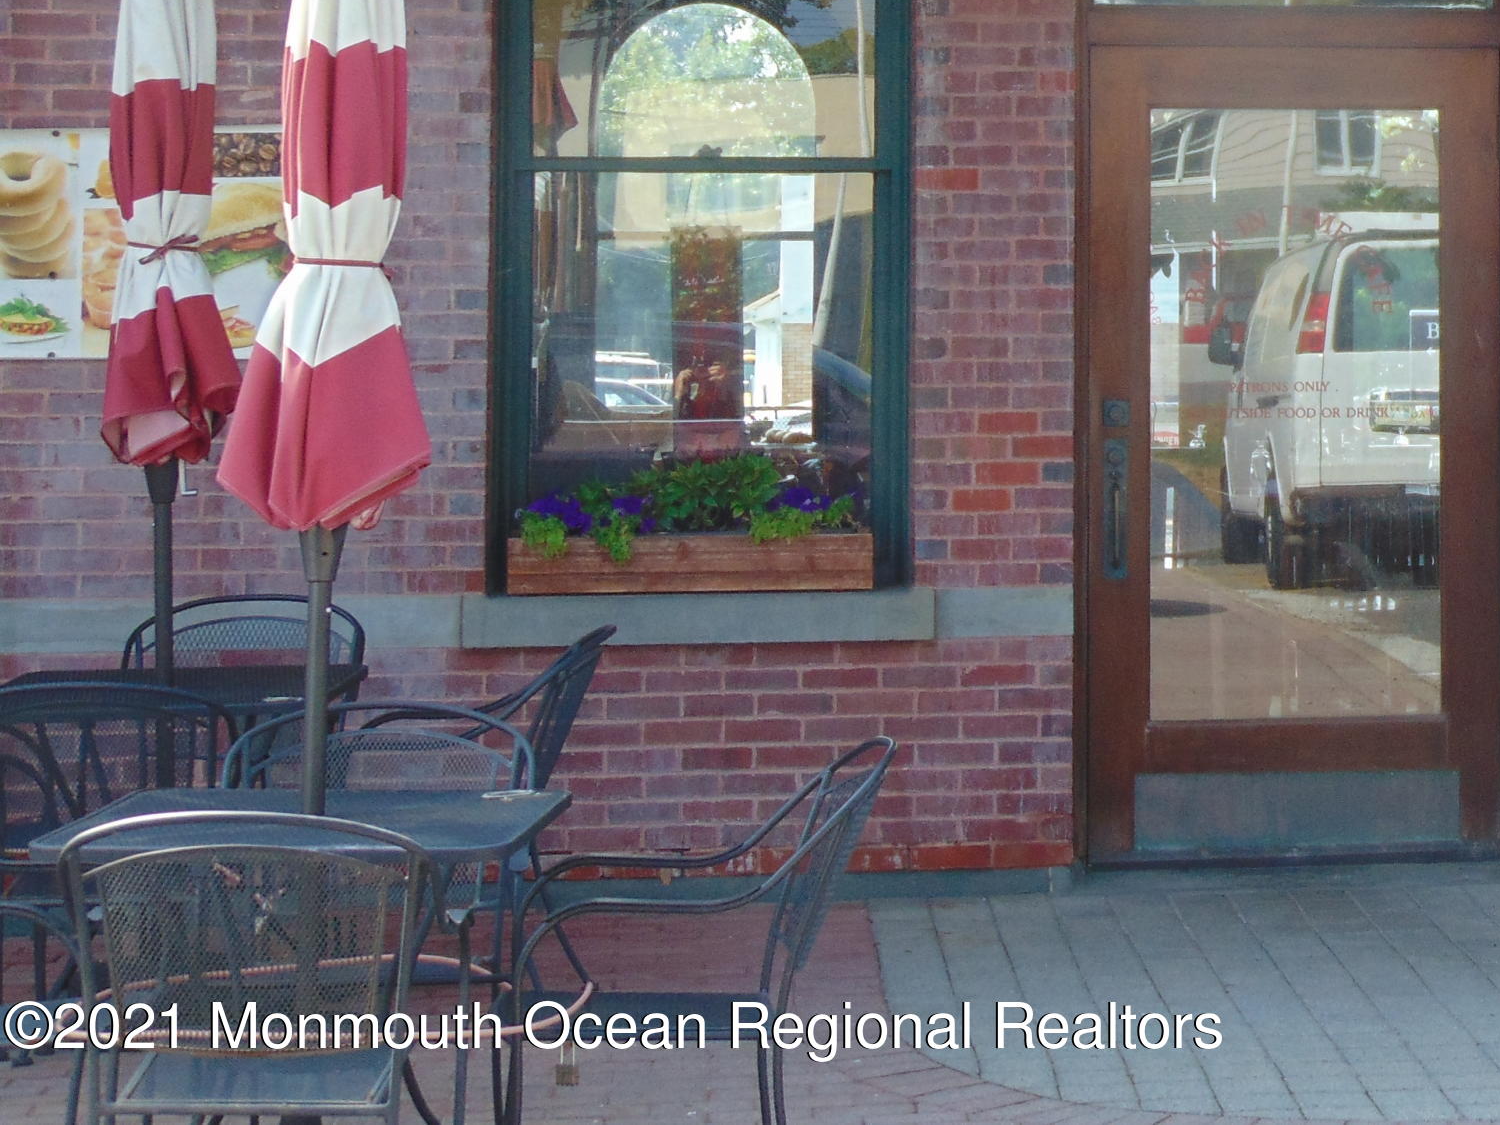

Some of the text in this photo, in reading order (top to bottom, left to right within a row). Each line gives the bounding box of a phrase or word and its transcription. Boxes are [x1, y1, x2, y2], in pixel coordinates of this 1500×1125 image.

[1294, 381, 1331, 393] ONLY
[1277, 406, 1316, 420] FOOD
[1321, 406, 1341, 420] OR
